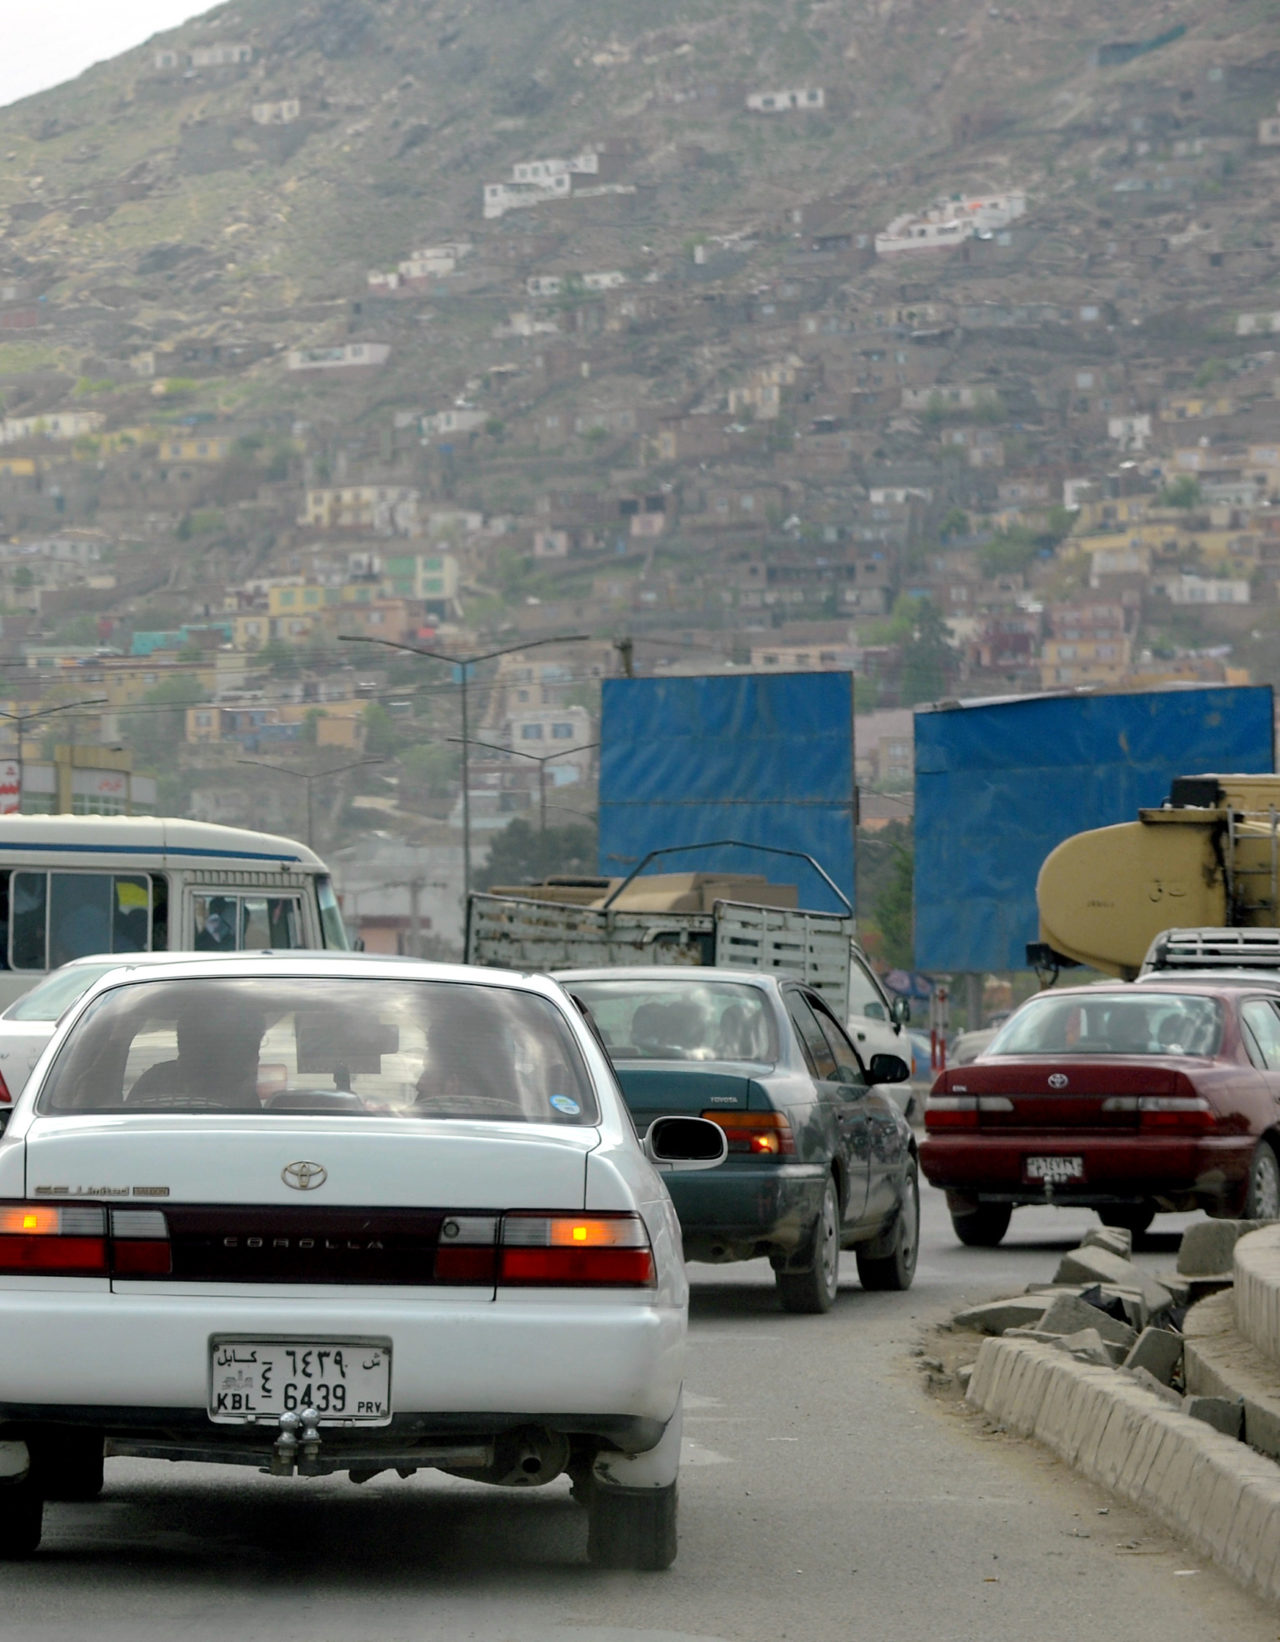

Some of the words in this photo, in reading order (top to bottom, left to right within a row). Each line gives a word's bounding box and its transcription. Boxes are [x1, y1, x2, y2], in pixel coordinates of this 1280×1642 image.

[223, 1236, 384, 1250] COROLLA
[285, 1349, 346, 1379] ٦٤٣٩
[217, 1393, 256, 1411] KBL
[284, 1383, 346, 1412] 6439
[357, 1401, 382, 1413] PRV
